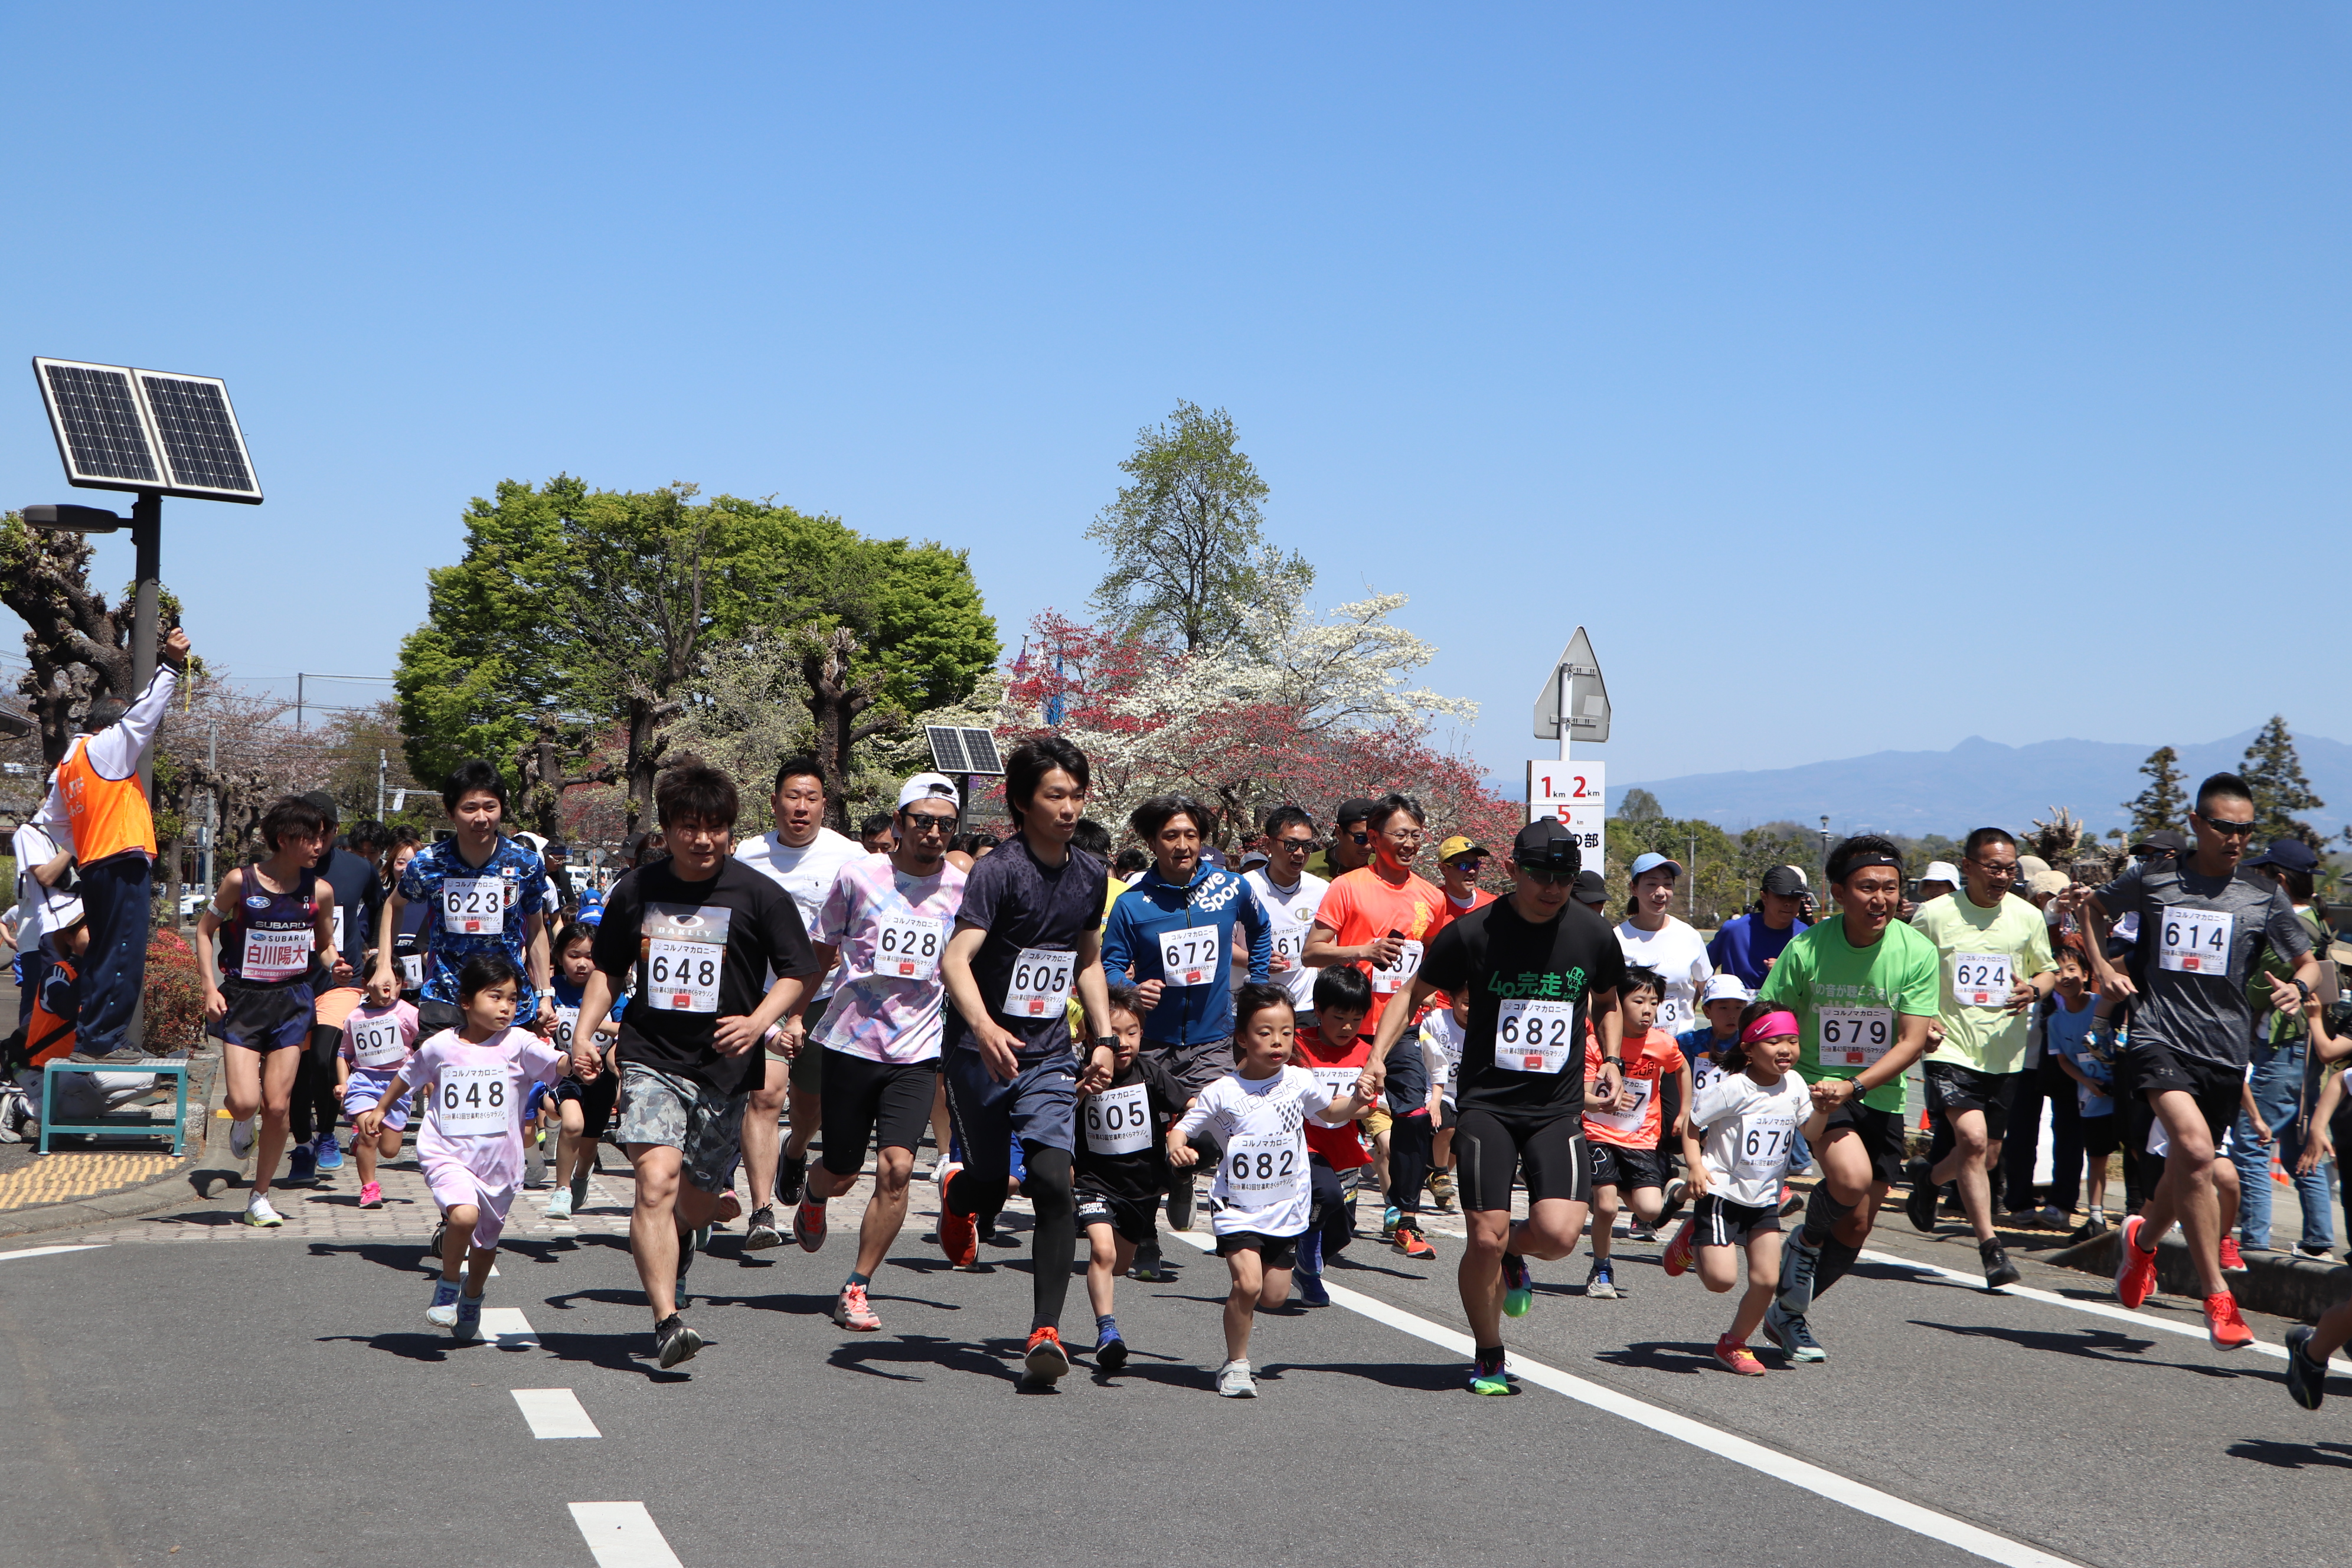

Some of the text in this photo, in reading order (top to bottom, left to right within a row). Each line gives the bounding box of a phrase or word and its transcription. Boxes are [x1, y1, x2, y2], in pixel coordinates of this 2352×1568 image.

[1557, 805, 1570, 825] 5
[448, 891, 498, 913] 623
[255, 920, 306, 929] SUBARU
[893, 917, 939, 927] コルノマカロニー
[2175, 912, 2226, 922] コルノマカロニー
[658, 927, 712, 937] OAKLEY
[882, 927, 936, 957] 628
[1171, 930, 1213, 940] コルノマカロニー
[2165, 922, 2224, 951] 614
[247, 944, 306, 965] 白川陽大
[663, 944, 717, 954] コルノマカロニー
[1029, 953, 1072, 962] コルノマカロニー
[1167, 939, 1216, 967] 672
[653, 956, 715, 986] 648
[1392, 953, 1418, 973] 37
[1015, 964, 1068, 992] 605
[1958, 965, 2005, 986] 624
[1514, 1004, 1567, 1013] コルノマカロニー
[358, 1018, 394, 1028] コルノマカロニー
[559, 1021, 607, 1042] 63
[1502, 1015, 1566, 1046] 682
[1824, 1020, 1886, 1044] 679
[356, 1025, 395, 1050] 607
[452, 1069, 504, 1077] コルノマカロニー
[444, 1081, 505, 1109] 648
[1092, 1090, 1141, 1102] コルノマカロニー
[1214, 1075, 1301, 1130] UNDER
[1595, 1083, 1646, 1111] 67
[1087, 1100, 1144, 1130] 605
[1242, 1138, 1293, 1147] コルノマカロニー
[1747, 1130, 1791, 1156] 679
[1233, 1149, 1293, 1180] 682
